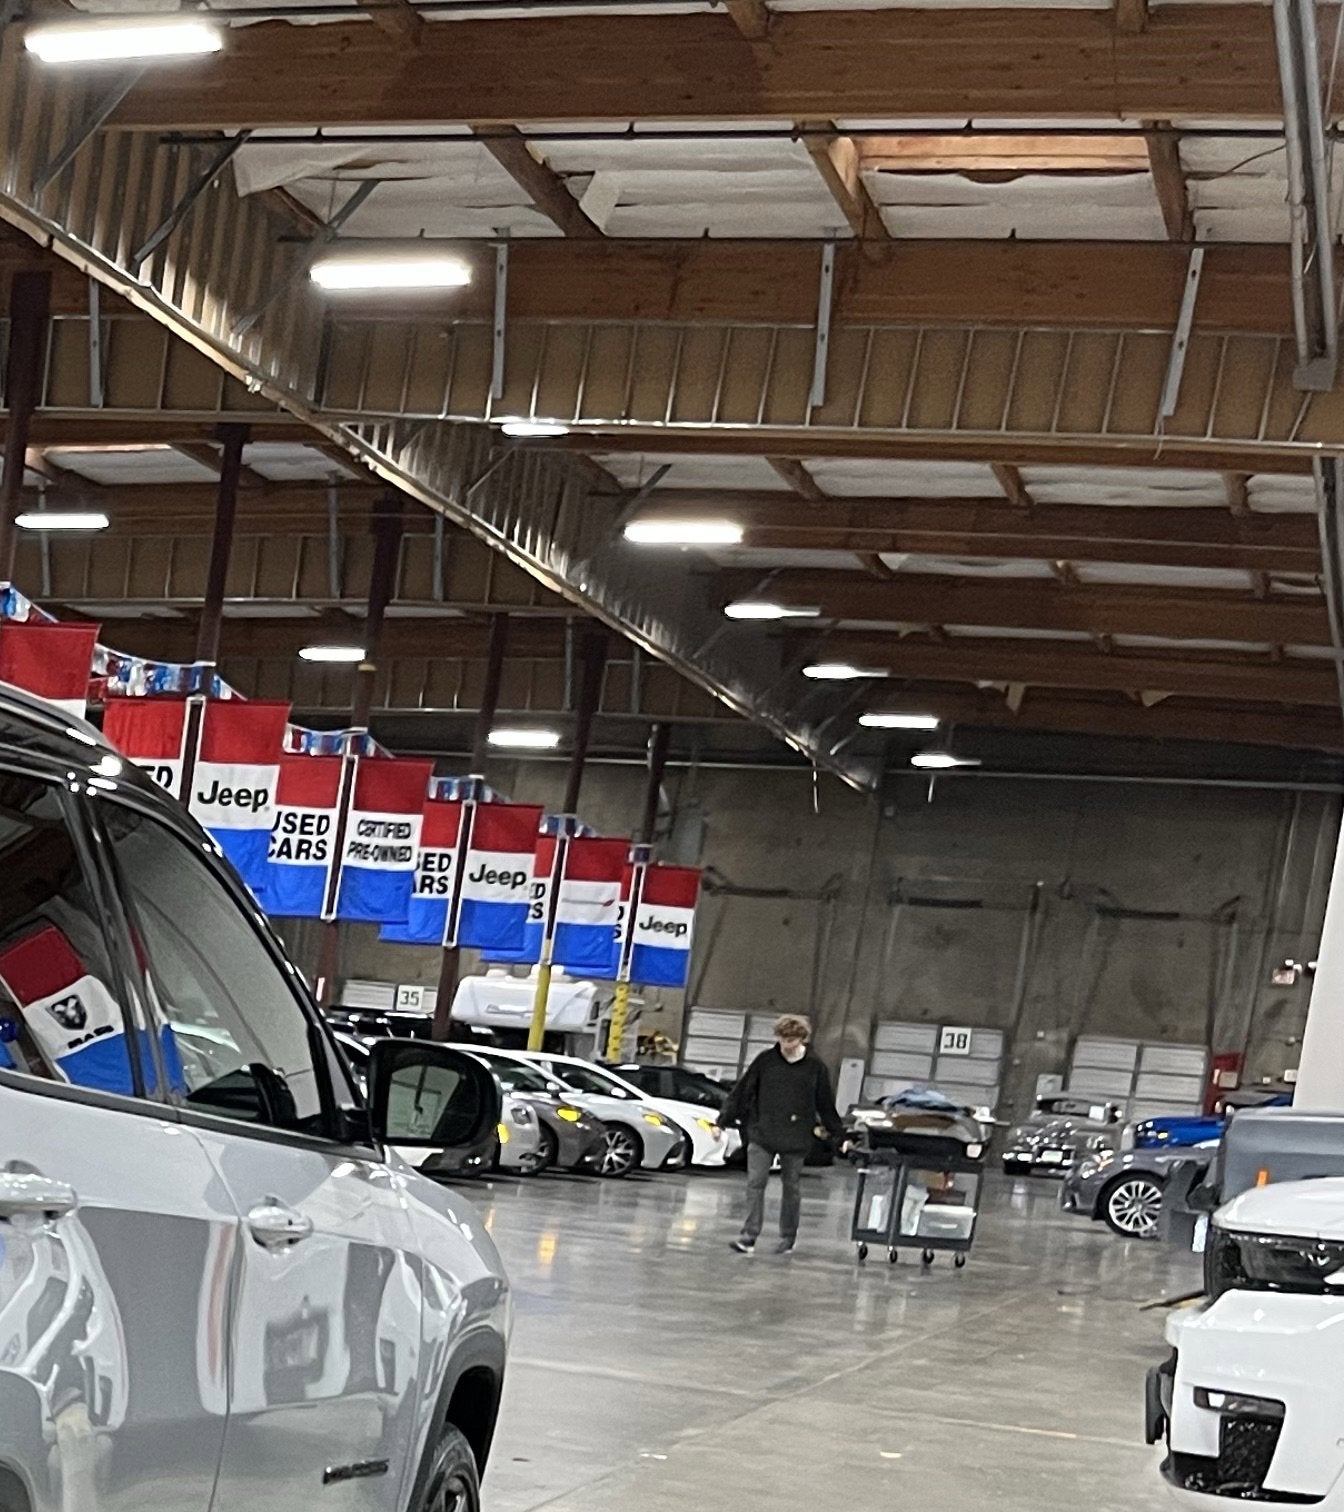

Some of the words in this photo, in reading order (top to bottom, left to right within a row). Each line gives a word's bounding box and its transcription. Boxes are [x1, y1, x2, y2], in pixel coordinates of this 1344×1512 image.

[197, 780, 269, 813] Jeep
[346, 841, 413, 862] PRE-OWNED
[417, 851, 452, 873] ED
[413, 874, 449, 894] RS
[469, 863, 527, 890] Jeep
[639, 915, 688, 938] Jeep
[400, 991, 419, 1006] 35
[944, 1032, 968, 1049] 38
